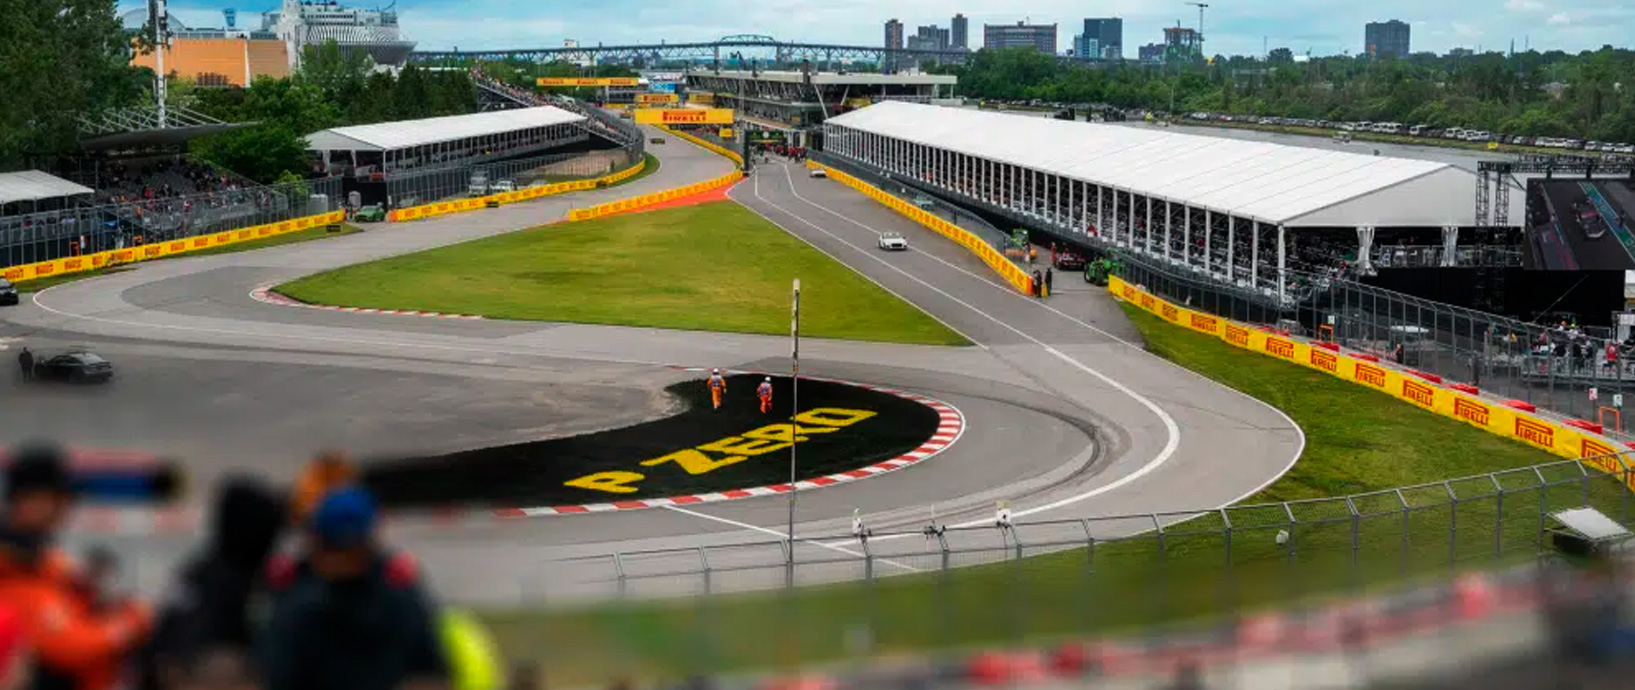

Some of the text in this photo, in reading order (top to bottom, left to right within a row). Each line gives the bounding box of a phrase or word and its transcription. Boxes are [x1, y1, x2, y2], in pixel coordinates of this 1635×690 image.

[662, 111, 706, 122] PIRELLI
[1266, 336, 1294, 359] PIRELLI
[1310, 348, 1338, 373] PIRELLI
[1355, 362, 1386, 388] PIRELLI
[1402, 379, 1434, 407] PIRELLI
[1454, 397, 1489, 426] PIRELLI
[1515, 417, 1554, 448] PIRELLI
[563, 407, 878, 493] P ZERO
